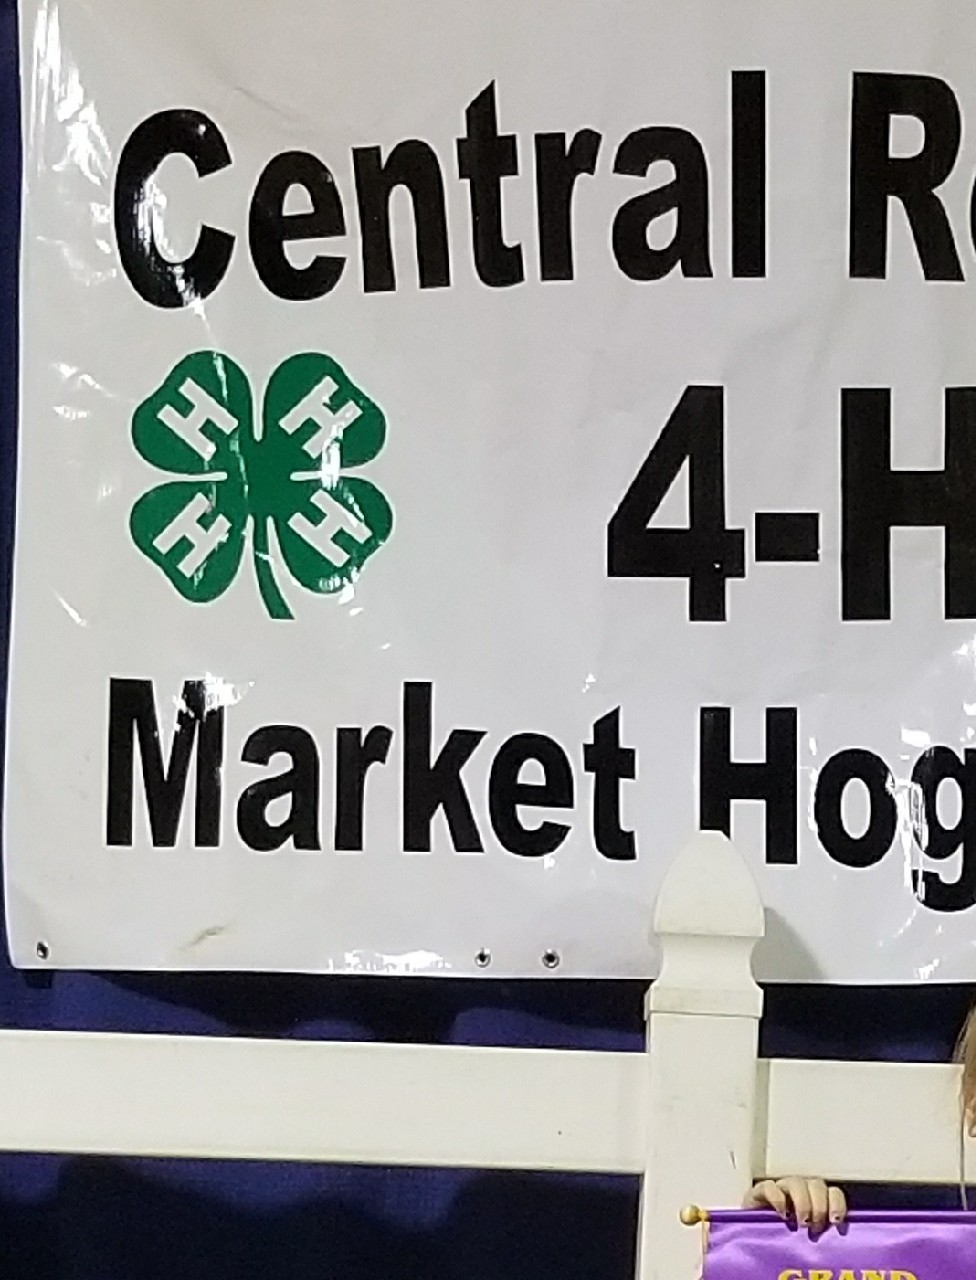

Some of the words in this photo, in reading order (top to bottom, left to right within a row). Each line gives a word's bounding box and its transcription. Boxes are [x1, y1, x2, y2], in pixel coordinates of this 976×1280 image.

[113, 69, 767, 310] Central
[156, 376, 240, 462] H
[278, 375, 364, 460] H
[152, 490, 233, 579] H
[287, 487, 372, 569] H
[105, 676, 639, 862] Market
